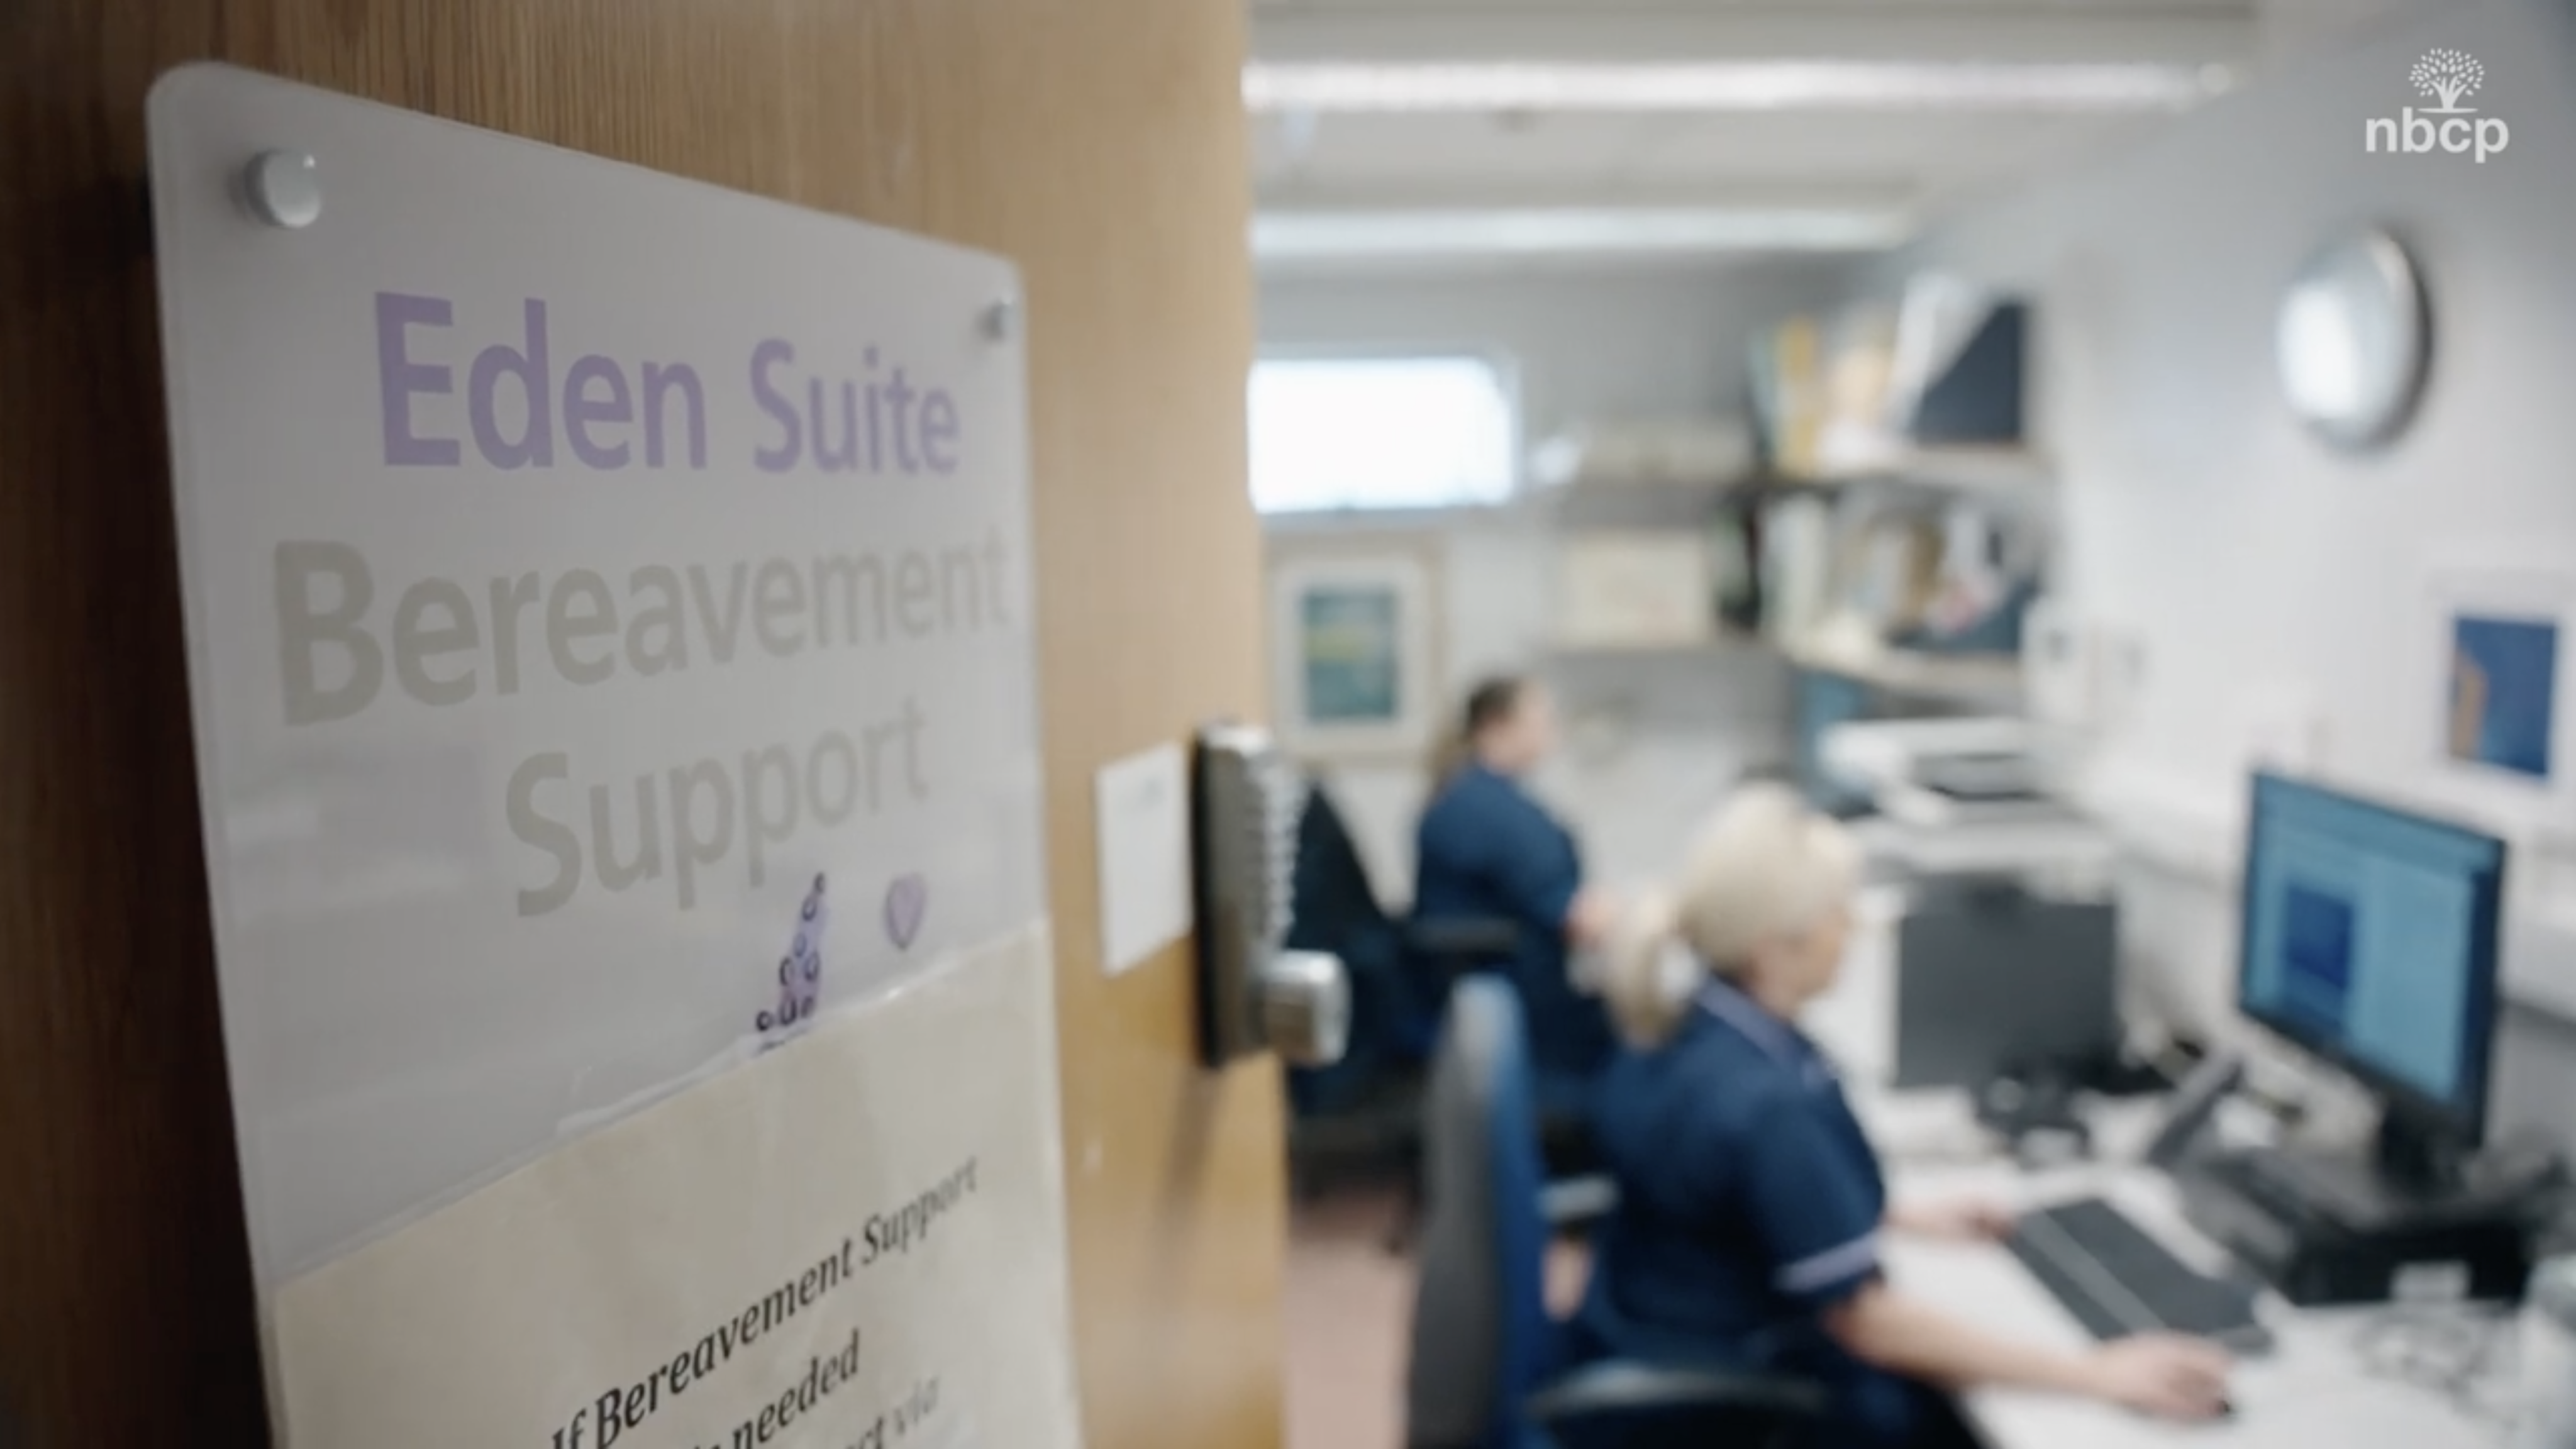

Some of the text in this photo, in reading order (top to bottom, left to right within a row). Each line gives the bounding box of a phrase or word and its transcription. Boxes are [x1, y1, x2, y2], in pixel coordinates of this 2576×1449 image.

[374, 291, 960, 475] Eden Suite
[273, 523, 1008, 726] Bereavement
[505, 695, 930, 917] Support
[595, 1237, 852, 1449] Bereavement
[861, 1155, 977, 1265] Support
[731, 1327, 858, 1449] needed
